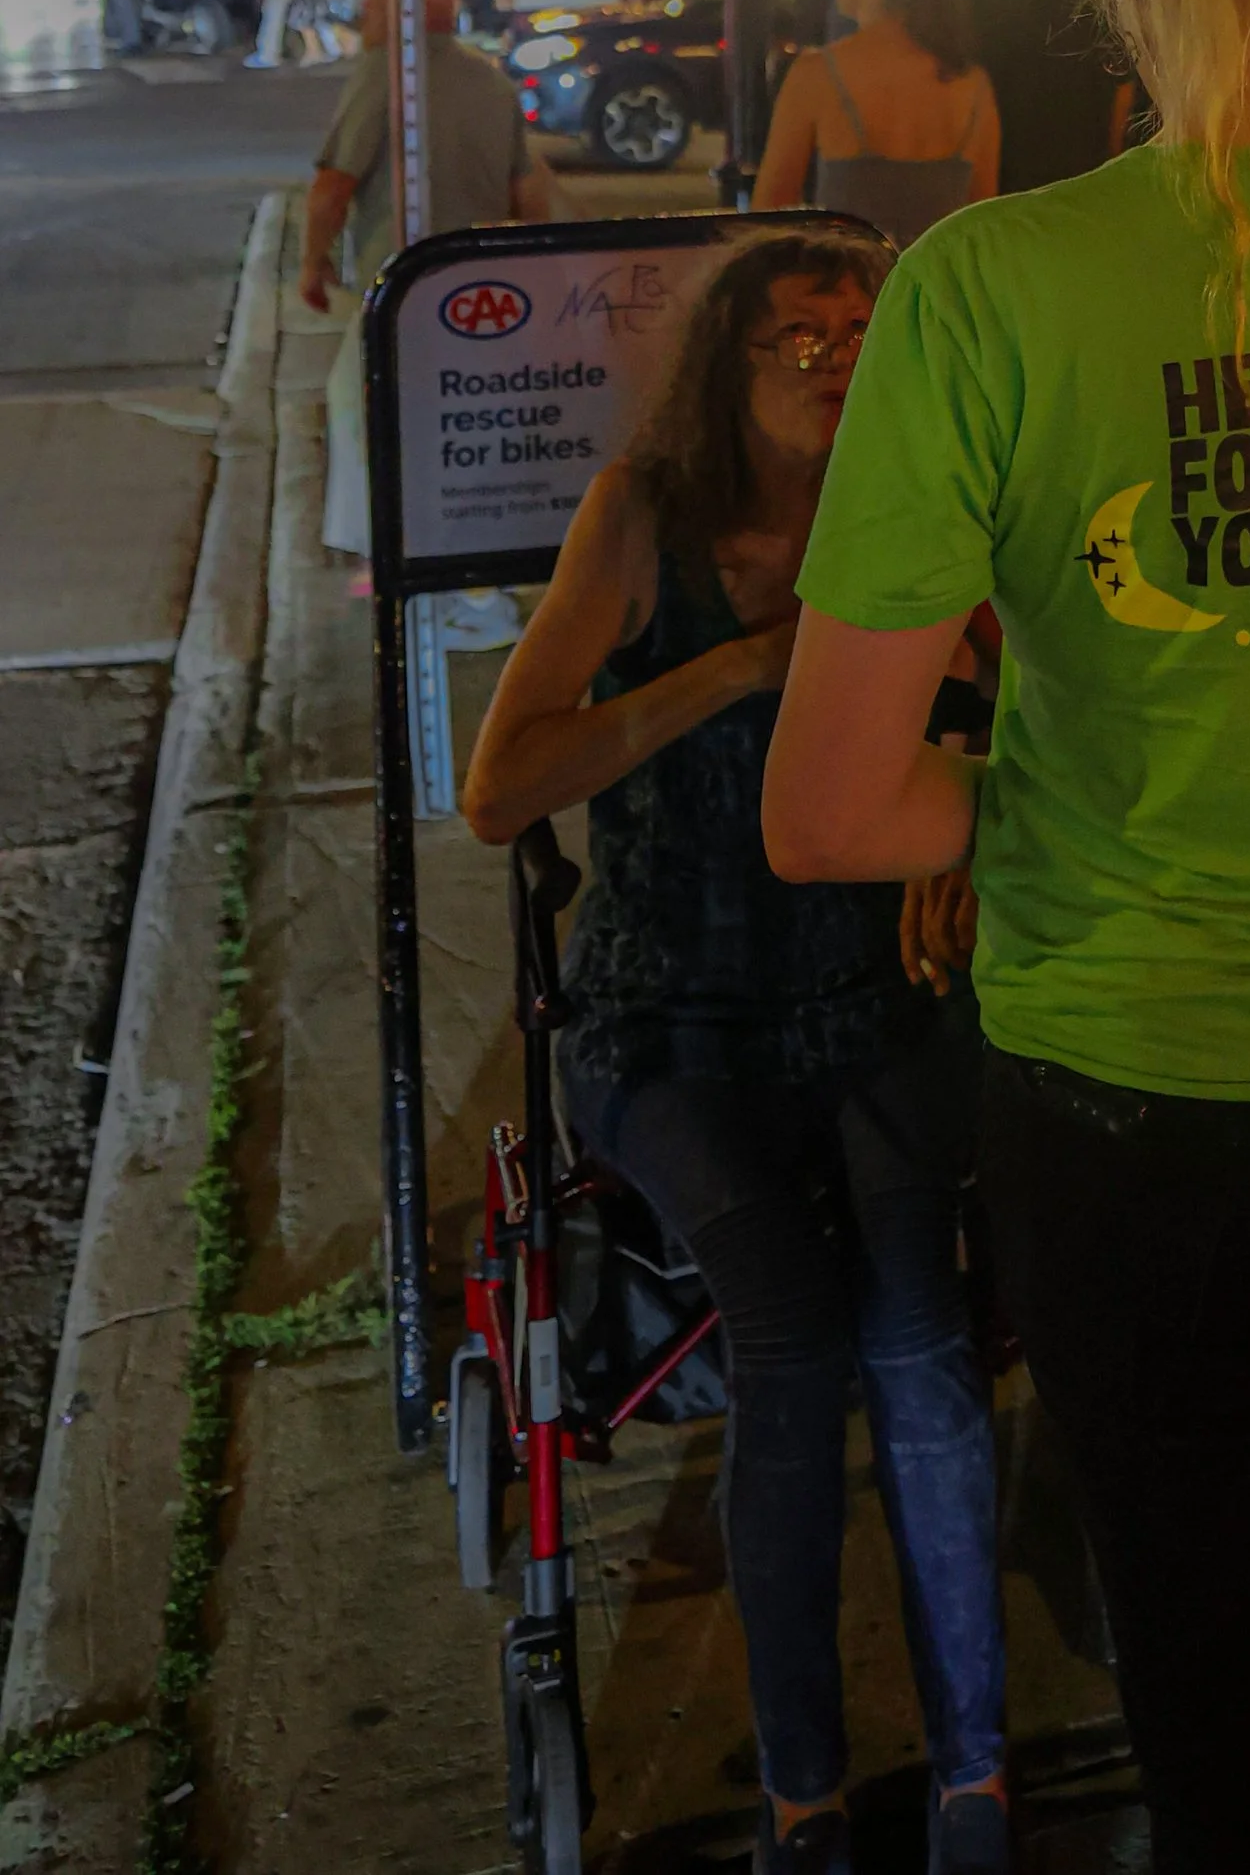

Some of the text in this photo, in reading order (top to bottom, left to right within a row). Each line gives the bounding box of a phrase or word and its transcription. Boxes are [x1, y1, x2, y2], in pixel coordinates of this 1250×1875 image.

[449, 287, 523, 332] CAA
[440, 361, 607, 397] Roadside
[440, 404, 562, 433] rescue
[441, 440, 491, 469] for
